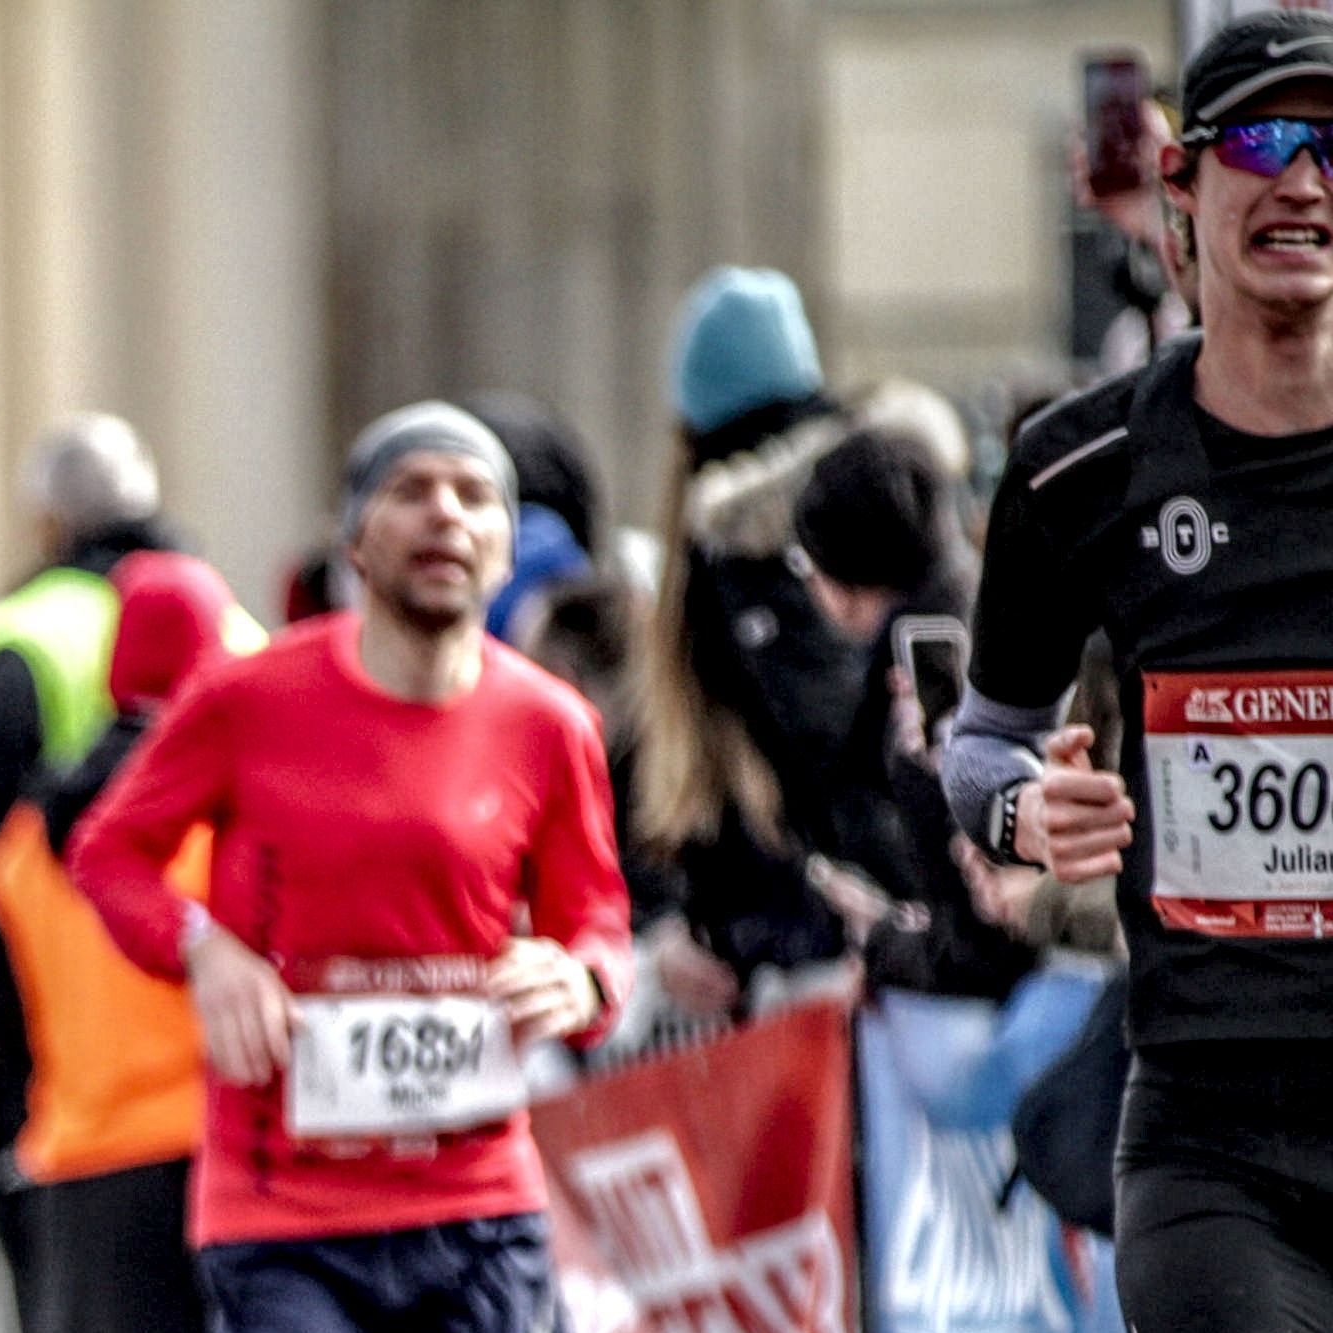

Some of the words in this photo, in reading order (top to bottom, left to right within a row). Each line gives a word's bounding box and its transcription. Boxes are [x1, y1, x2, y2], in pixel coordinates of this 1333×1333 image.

[1234, 687, 1333, 722] GENE
[1194, 744, 1211, 763] A
[1207, 762, 1333, 834] 360
[1263, 843, 1333, 874] Julia
